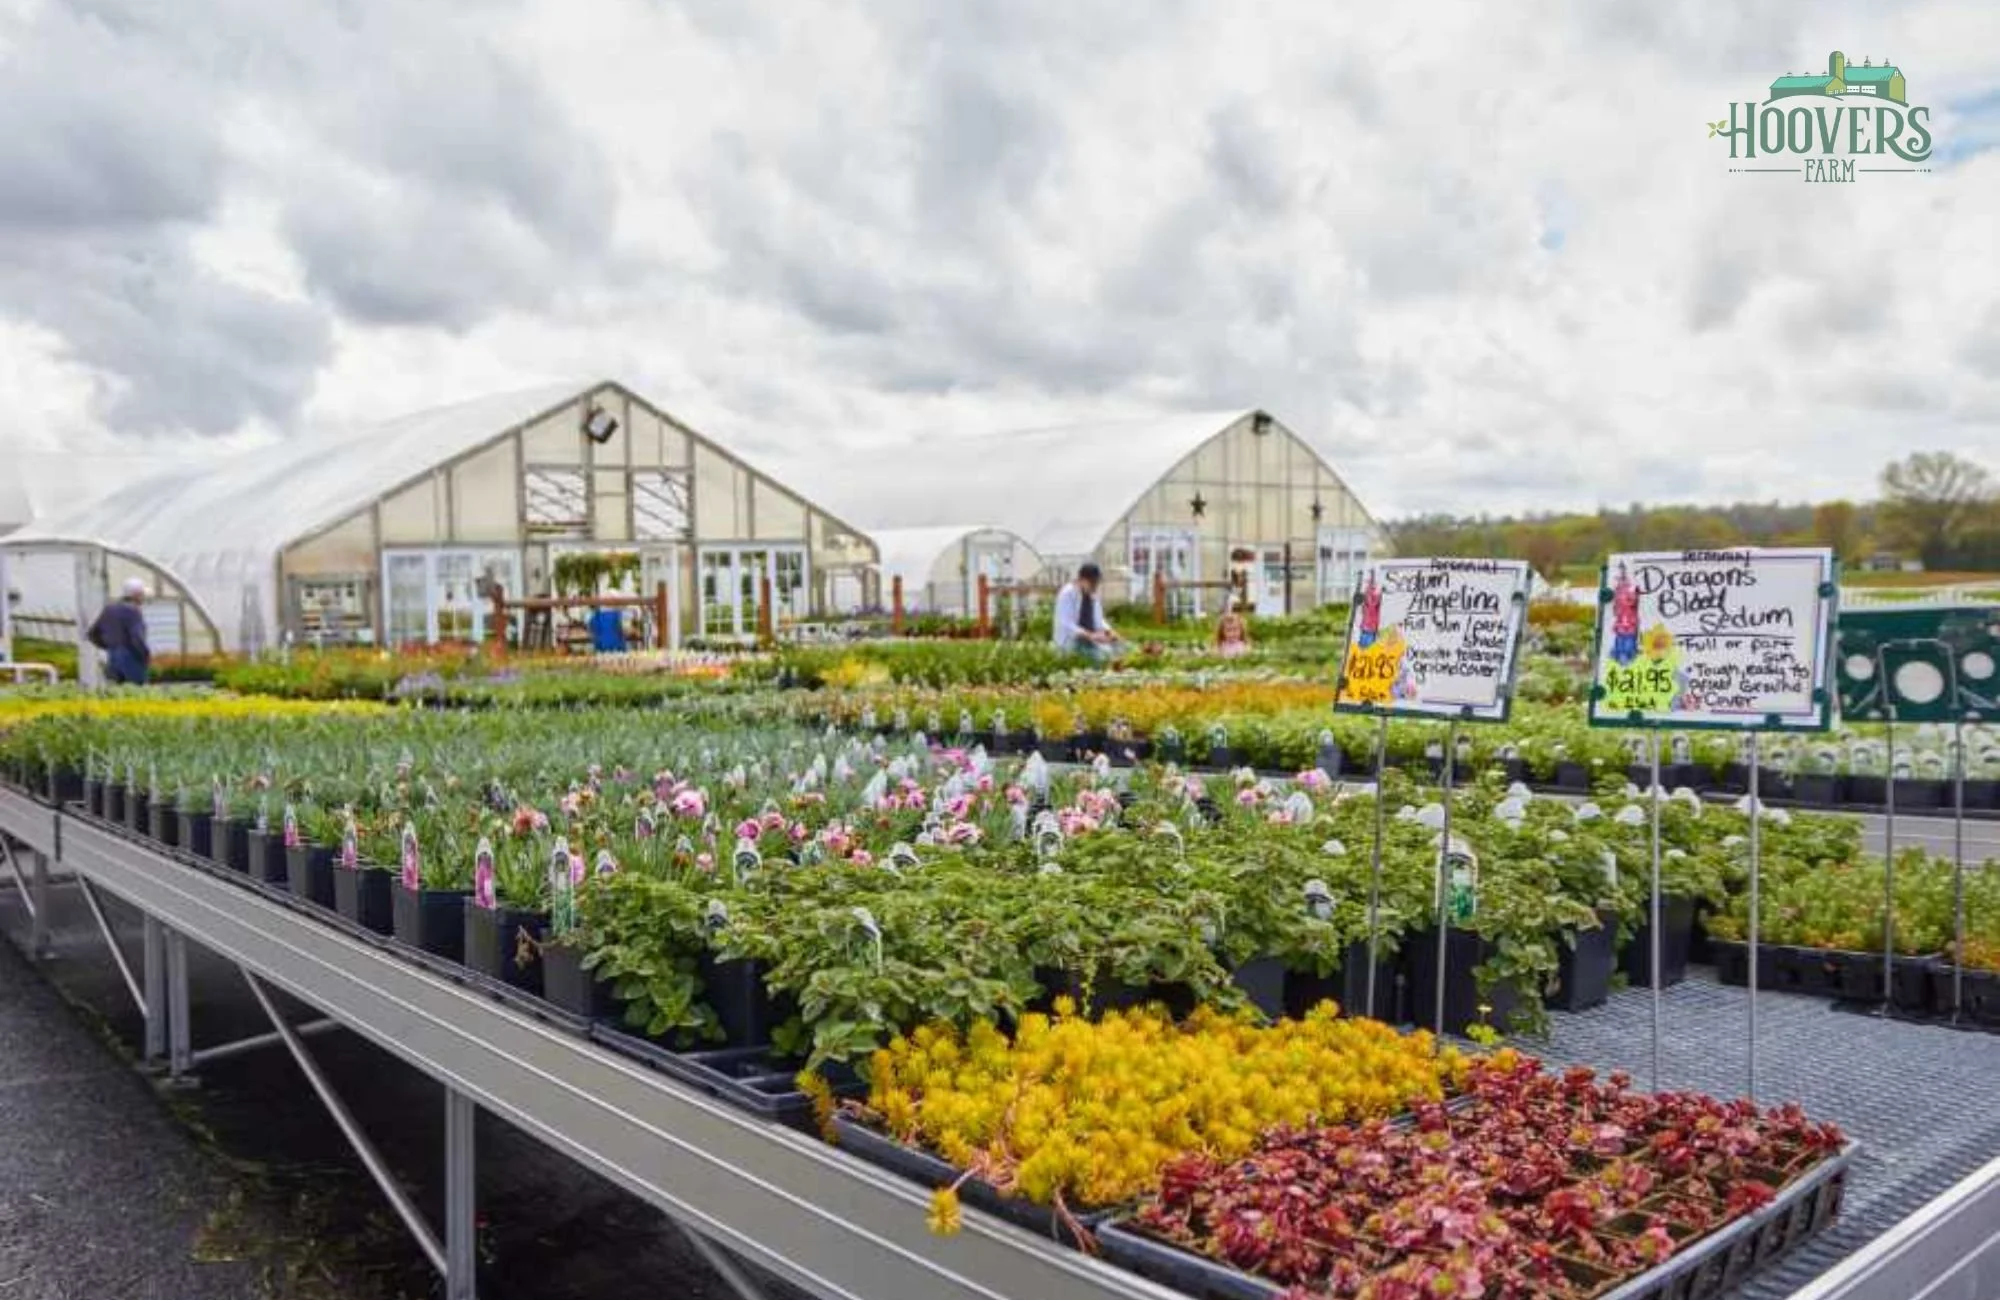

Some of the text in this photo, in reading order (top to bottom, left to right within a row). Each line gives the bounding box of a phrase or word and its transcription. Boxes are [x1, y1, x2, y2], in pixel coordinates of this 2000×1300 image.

[1383, 570, 1449, 593] Sedum
[1635, 565, 1757, 598] Dragons
[1408, 585, 1500, 628] Angelina
[1658, 587, 1726, 618] Blood
[1725, 640, 1743, 650] or
[1750, 638, 1794, 653] part
[1607, 668, 1672, 694] $21.95
